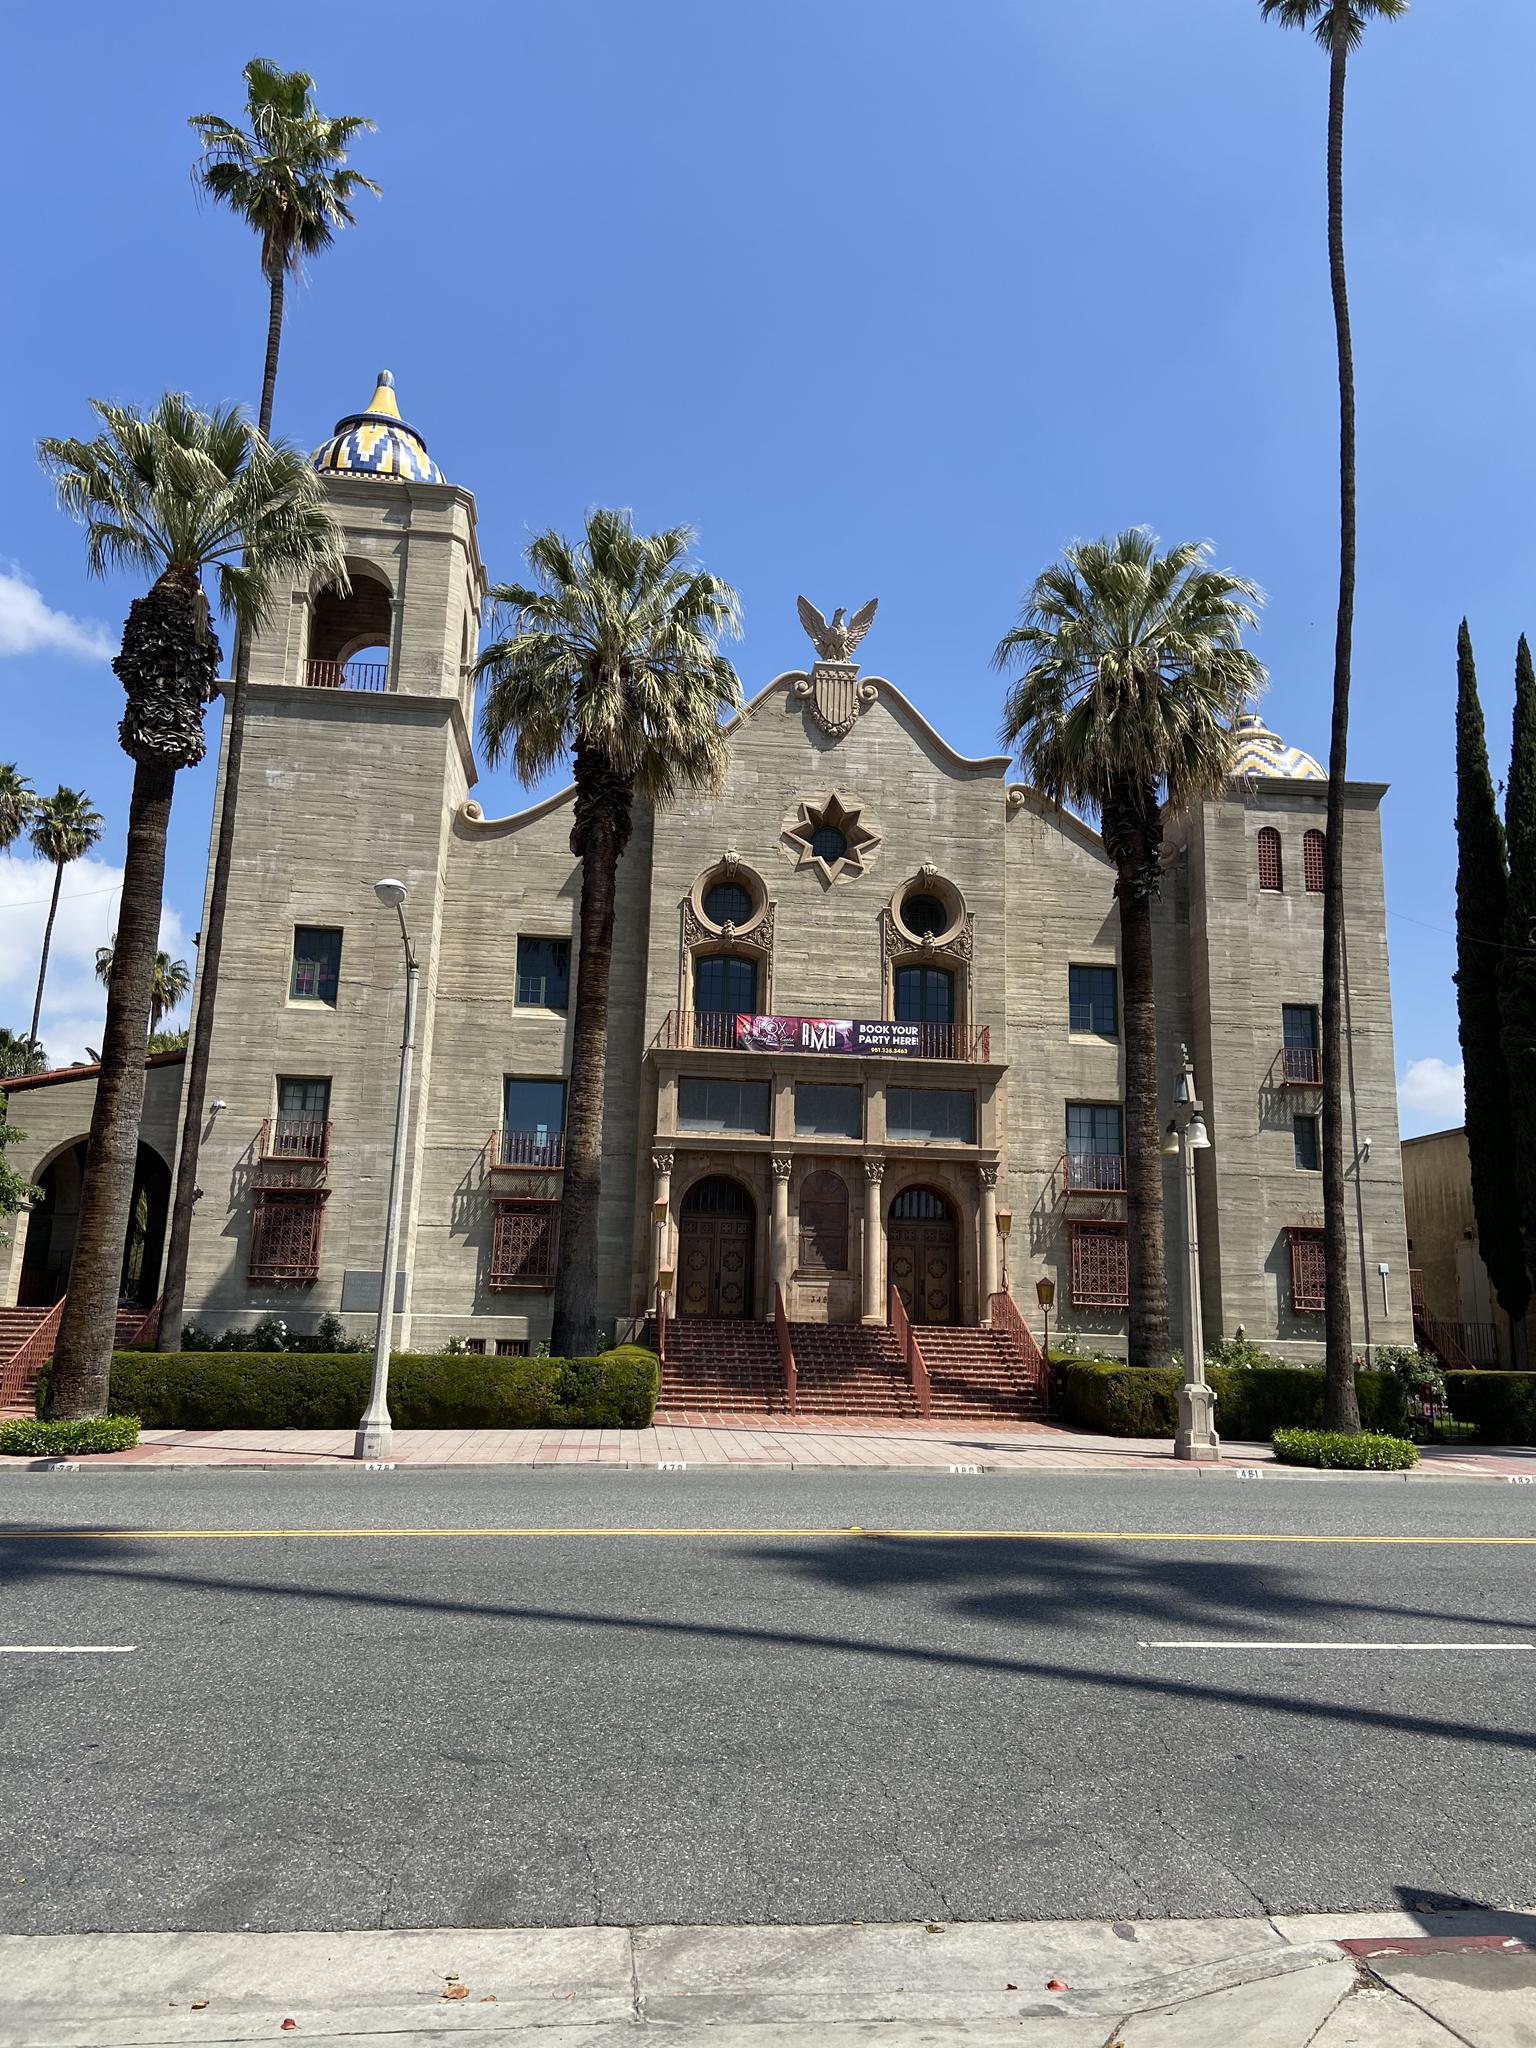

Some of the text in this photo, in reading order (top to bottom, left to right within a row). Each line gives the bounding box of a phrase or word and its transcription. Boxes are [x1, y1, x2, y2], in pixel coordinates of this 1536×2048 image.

[758, 1020, 787, 1035] FOX
[860, 1024, 919, 1035] BOOK YOUR
[858, 1034, 919, 1046] PARTY HERE!
